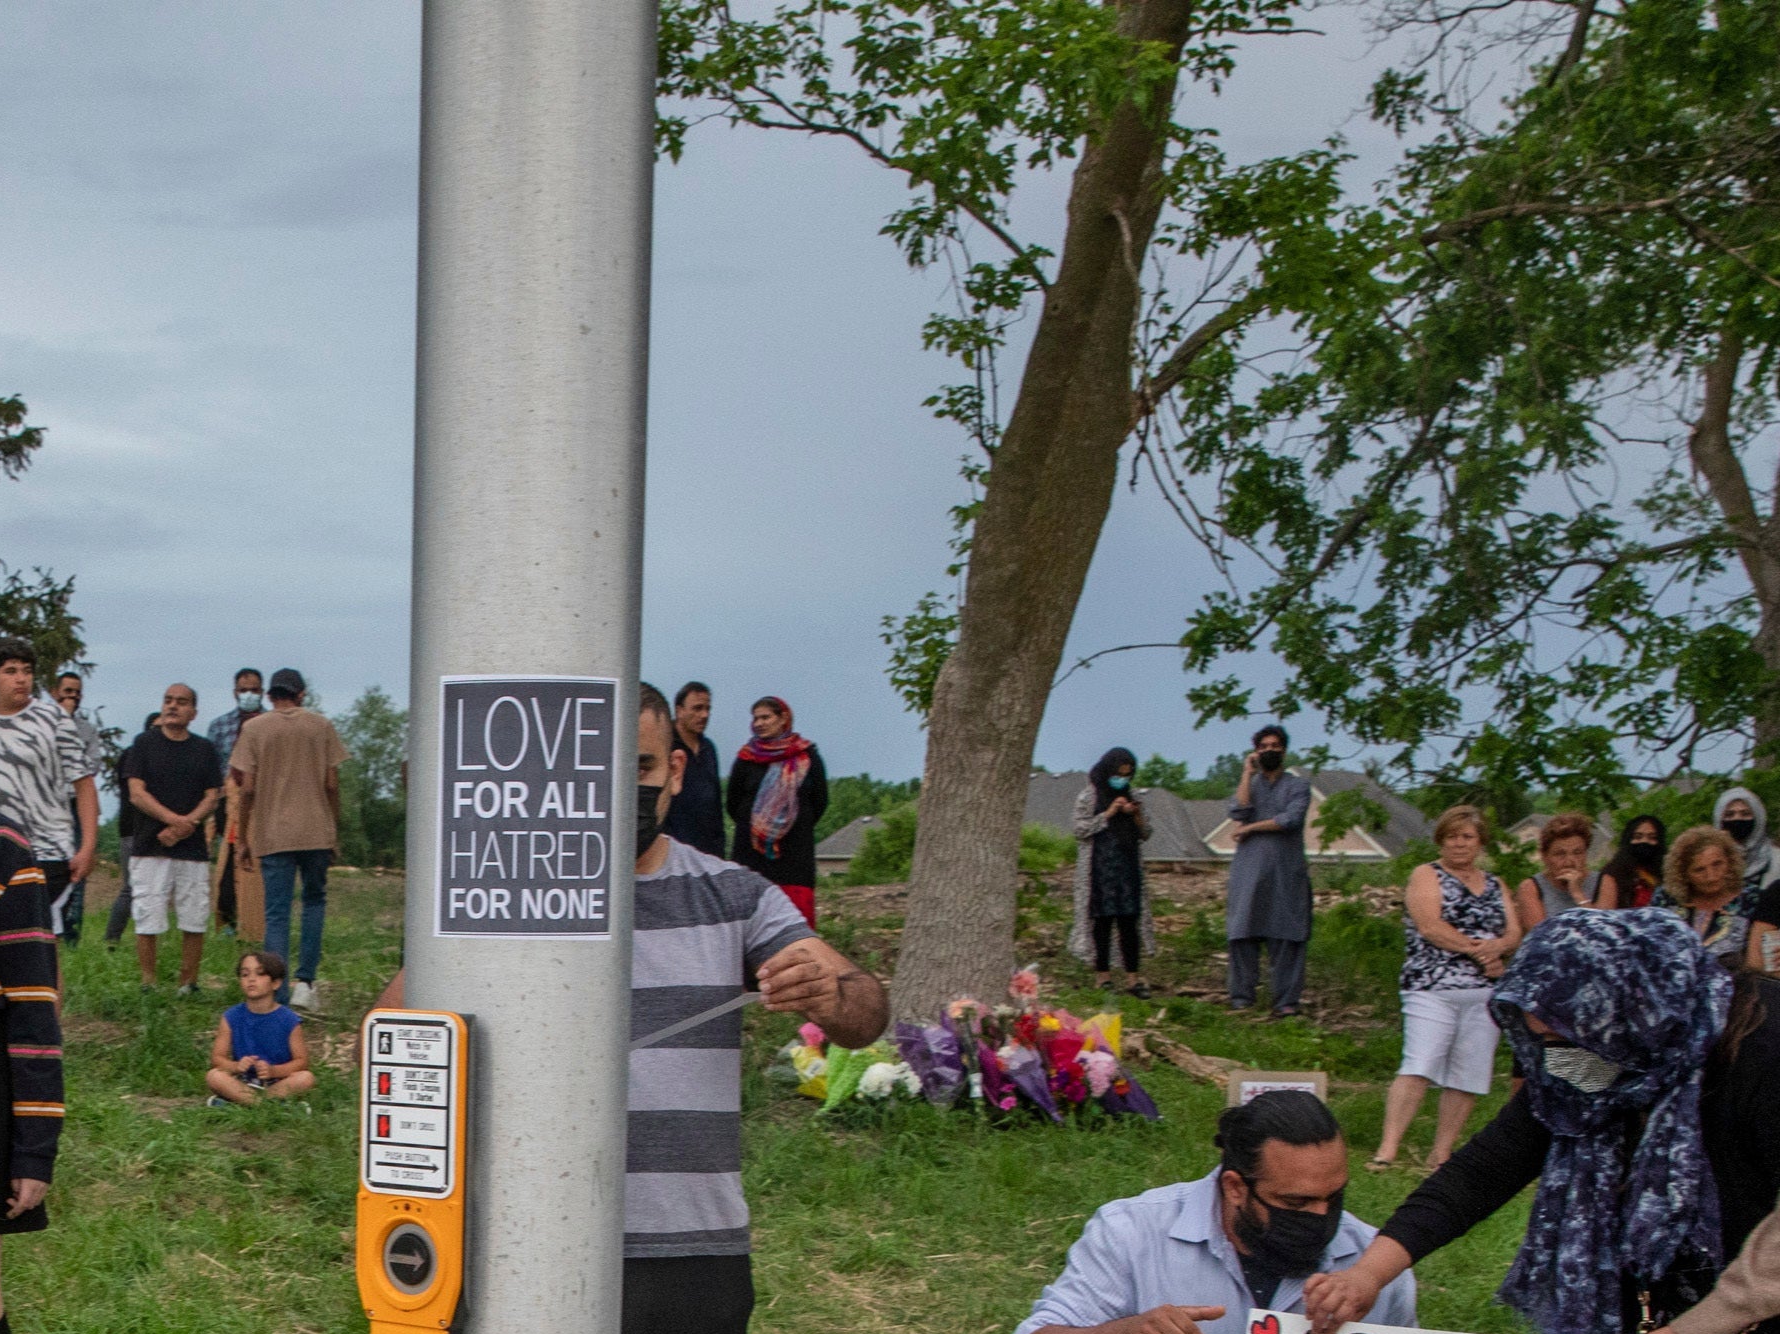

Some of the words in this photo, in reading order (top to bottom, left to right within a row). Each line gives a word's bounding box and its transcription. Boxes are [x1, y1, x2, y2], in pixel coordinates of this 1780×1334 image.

[456, 696, 606, 771] LOVE
[452, 781, 529, 818] FOR
[538, 781, 606, 819] ALL
[450, 830, 606, 880] HATRED
[448, 887, 511, 920] FOR
[521, 888, 605, 920] NONE
[384, 1151, 402, 1160] PUSH
[404, 1153, 430, 1162] BUTTON
